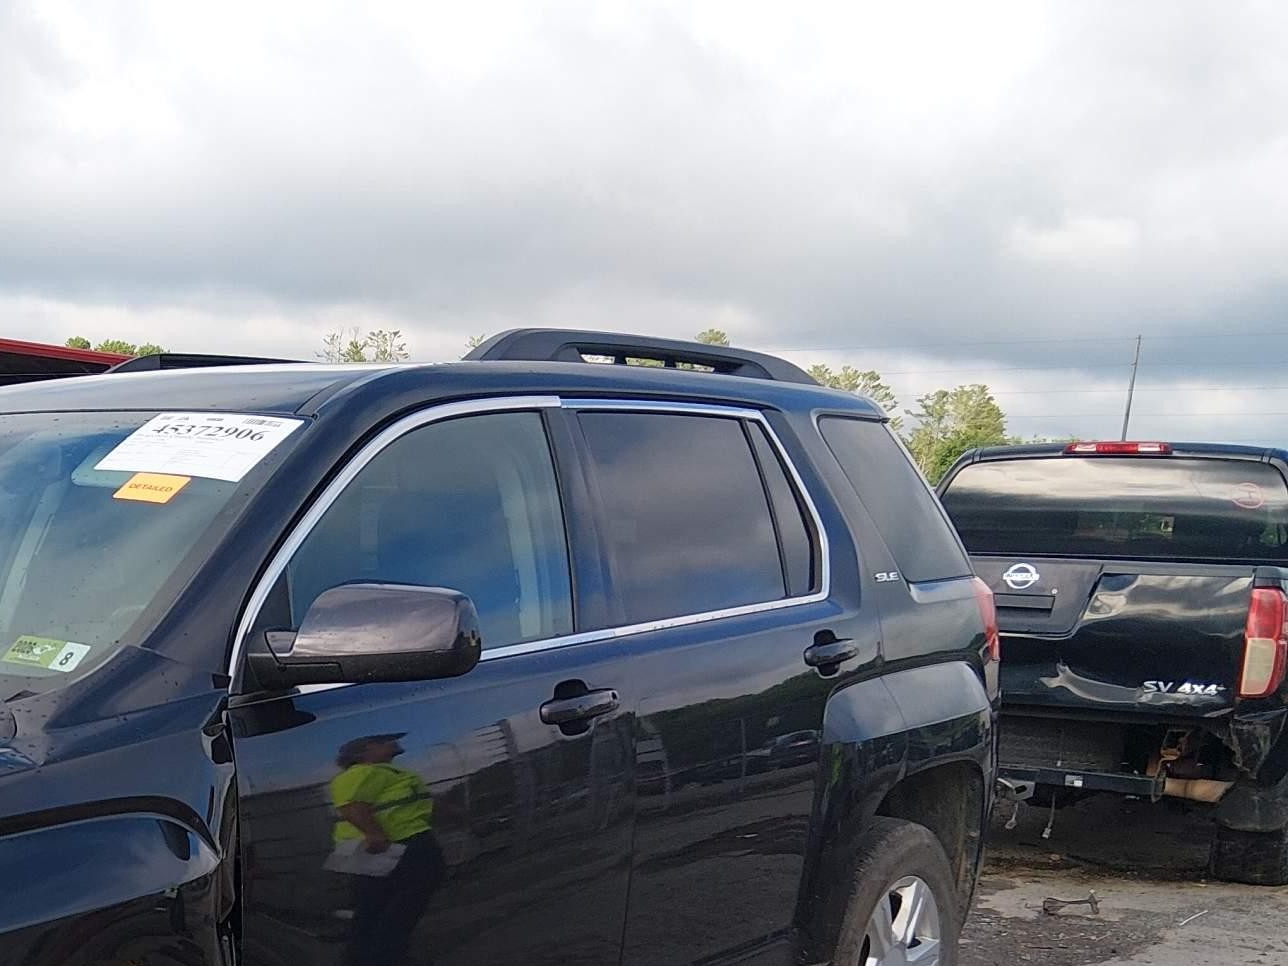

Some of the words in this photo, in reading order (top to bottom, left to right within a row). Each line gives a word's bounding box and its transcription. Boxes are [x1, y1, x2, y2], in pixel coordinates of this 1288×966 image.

[152, 424, 270, 441] 45372906
[128, 482, 173, 493] DETAILED
[874, 571, 900, 582] SLE
[58, 651, 74, 666] 8
[1143, 680, 1174, 693] SV
